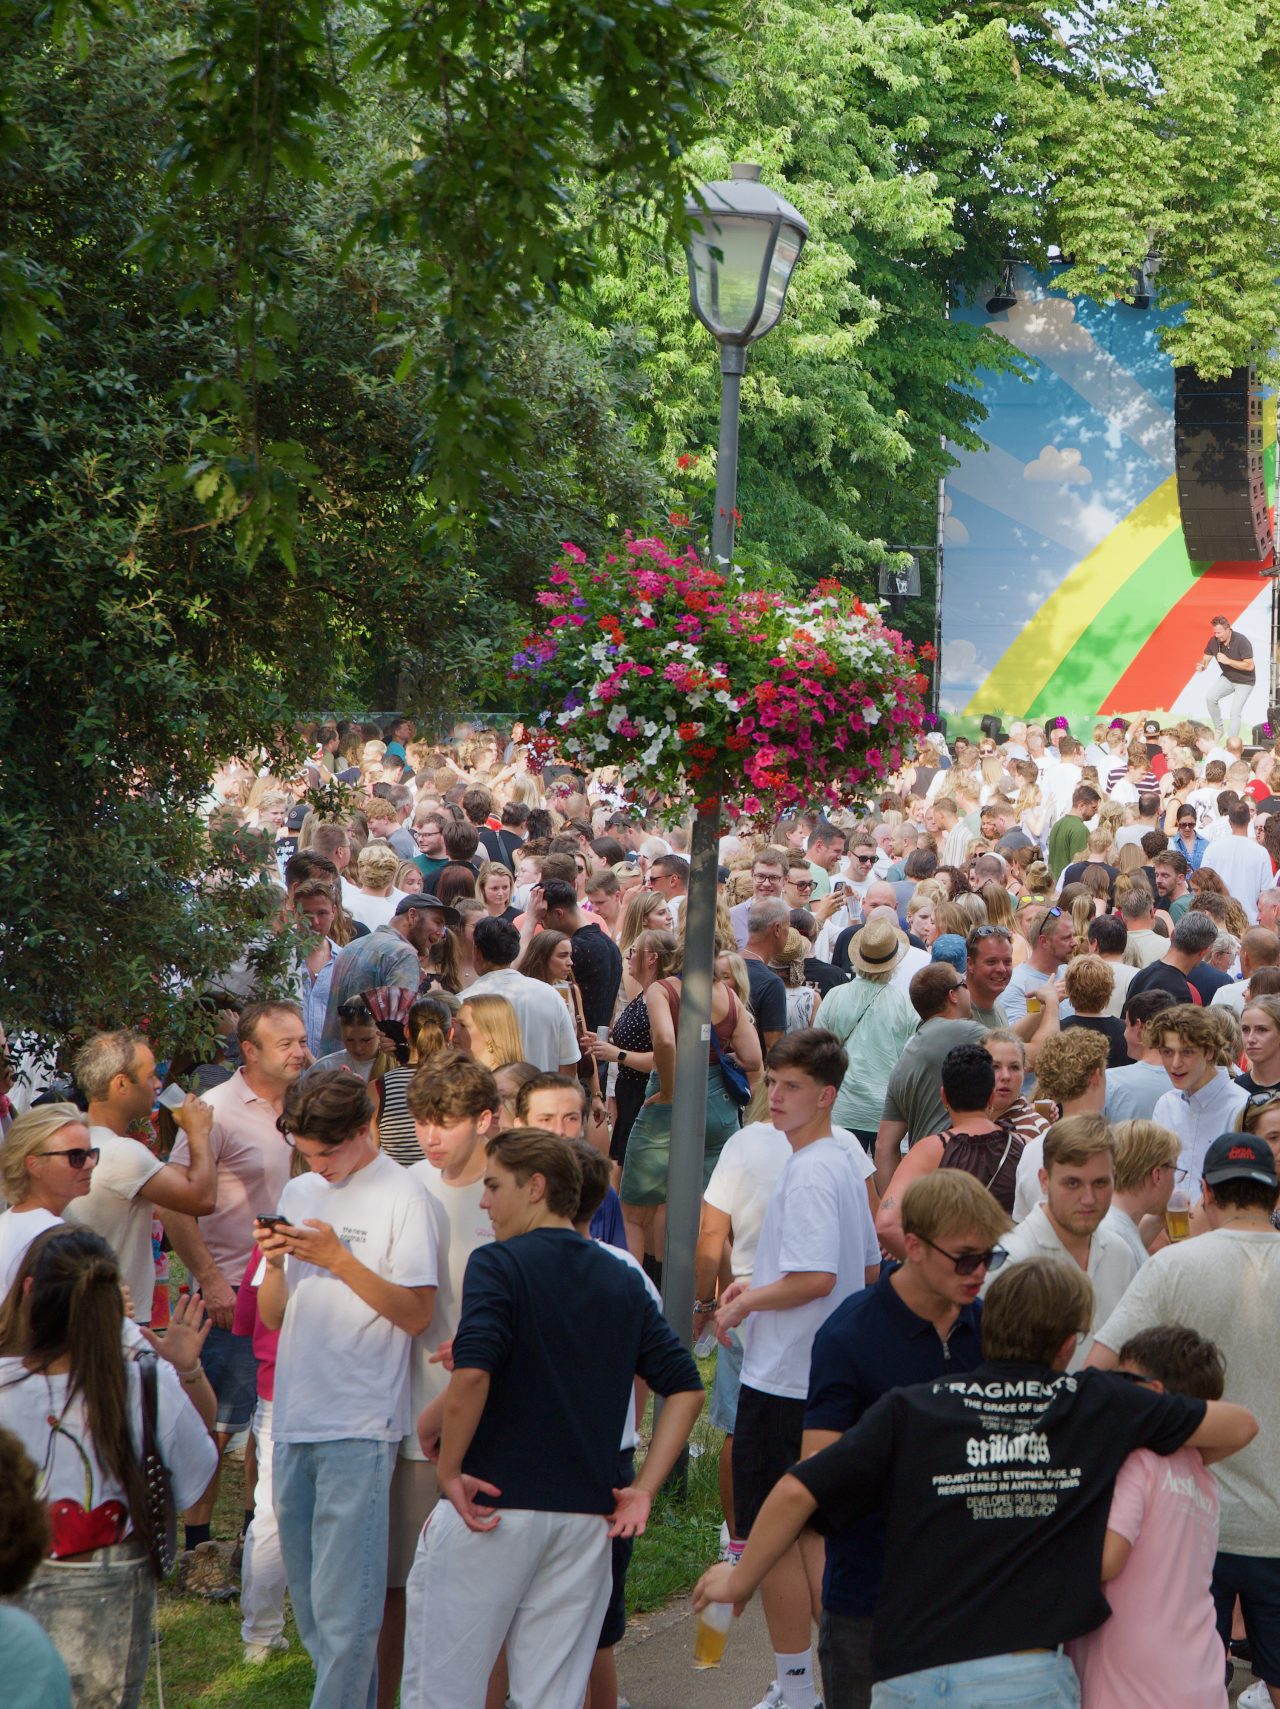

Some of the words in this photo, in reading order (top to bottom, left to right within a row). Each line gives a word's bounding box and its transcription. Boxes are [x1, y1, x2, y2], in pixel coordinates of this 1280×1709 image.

[963, 1398, 982, 1410] THE
[983, 1402, 1017, 1413] GRACE
[1018, 1402, 1032, 1413] OF
[932, 1472, 976, 1486] PROJECT
[1003, 1470, 1045, 1480] ETERNAL
[937, 1482, 998, 1496] REGISTERED
[999, 1481, 1009, 1492] IN
[966, 1493, 1013, 1509] DEVELOPED
[1015, 1493, 1031, 1505] FOR
